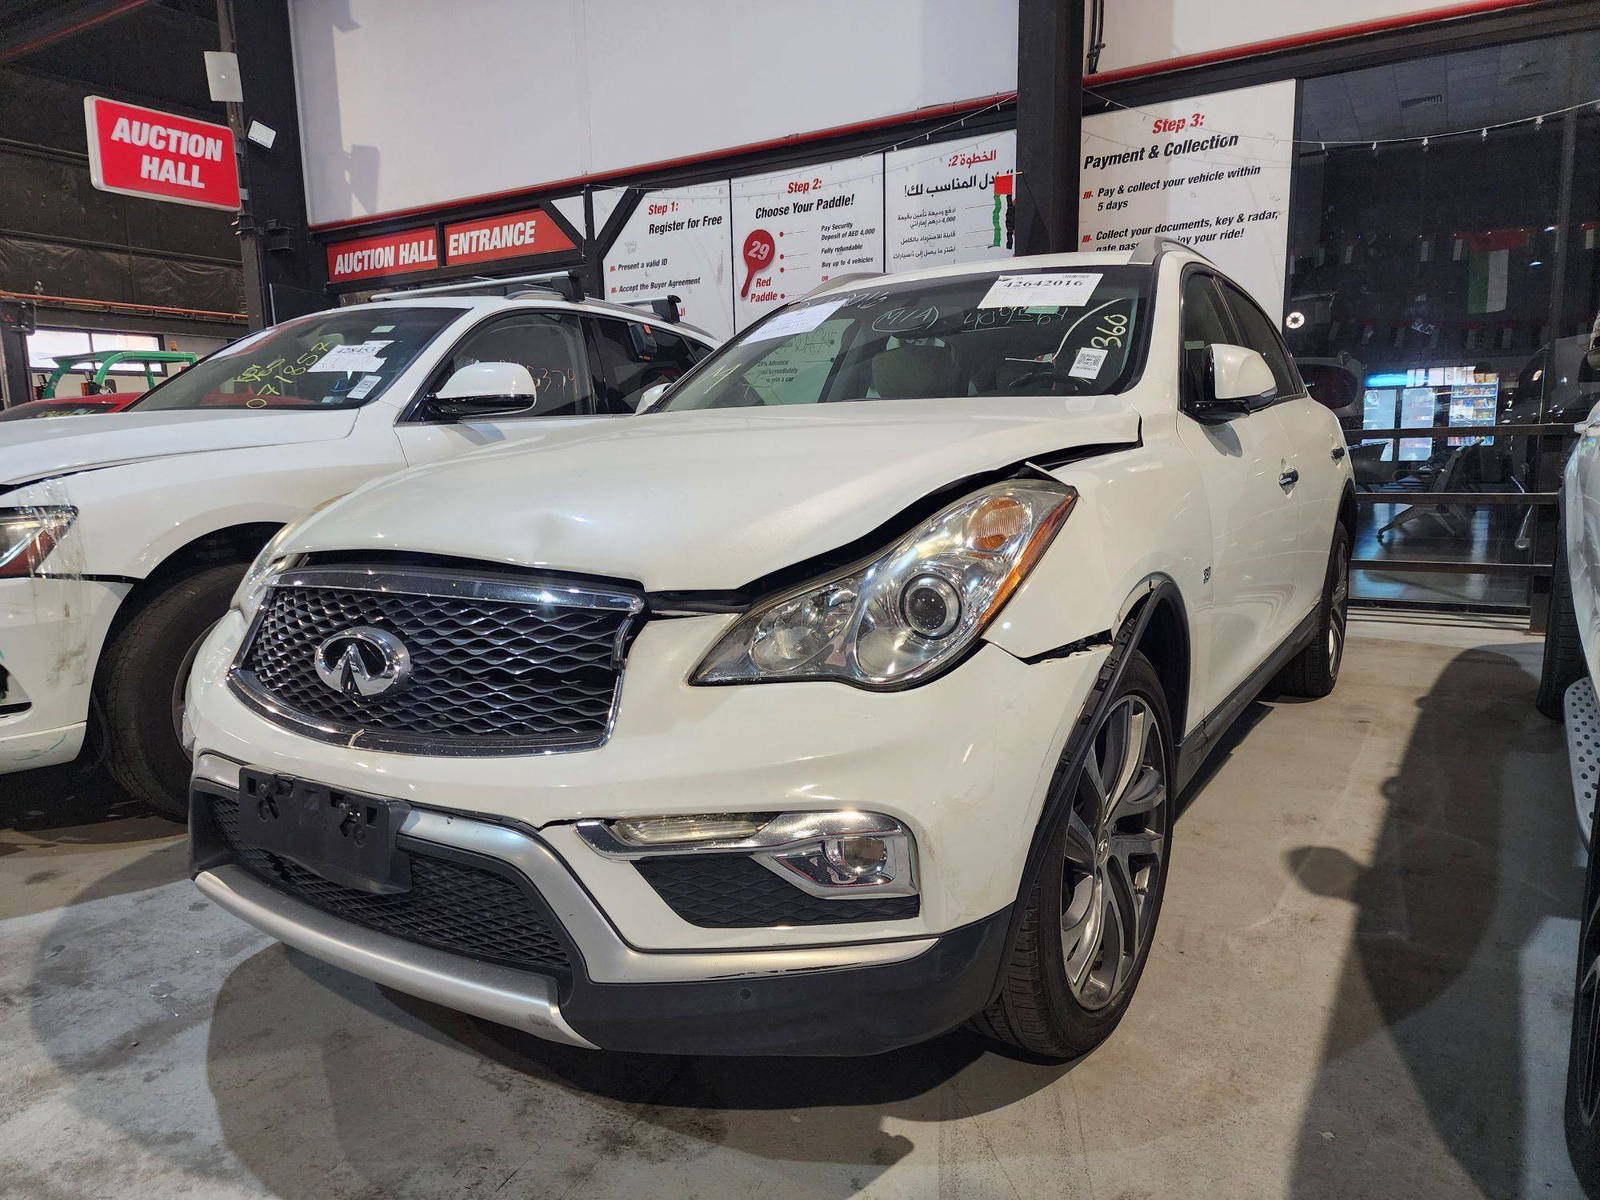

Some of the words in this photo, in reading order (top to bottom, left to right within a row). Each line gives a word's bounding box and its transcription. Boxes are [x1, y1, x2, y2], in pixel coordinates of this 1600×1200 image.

[1152, 118, 1186, 134] Step
[1190, 113, 1204, 128] 3:
[111, 117, 222, 162] AUCTION
[960, 149, 997, 168] الخطوة
[1083, 147, 1145, 170] Payment
[1148, 145, 1160, 160] &
[1163, 135, 1239, 157] Collection
[140, 155, 205, 188] HALL
[787, 182, 810, 194] Step
[812, 178, 822, 190] 2:
[904, 184, 923, 198] لك!
[925, 174, 977, 198] المناسب
[1097, 187, 1115, 200] Pay
[1117, 185, 1125, 194] &
[1127, 181, 1160, 194] collect
[1163, 178, 1185, 190] your
[1187, 171, 1224, 184] vehicle
[1227, 165, 1261, 179] within
[648, 204, 668, 216] Step
[671, 201, 679, 212] 1:
[755, 206, 789, 219] Choose
[792, 202, 814, 214] Your
[816, 194, 855, 210] Paddle!
[1097, 202, 1103, 211] 5
[1105, 199, 1129, 212] days
[649, 222, 685, 236] Register
[687, 218, 700, 230] for
[702, 215, 723, 227] Free
[832, 222, 853, 231] Security
[860, 228, 876, 236] 4,000
[1096, 228, 1128, 241] Collect
[1131, 226, 1152, 238] your
[1154, 217, 1213, 234] documents,
[1215, 215, 1234, 227] key
[1236, 213, 1245, 223] &
[1247, 209, 1279, 222] radar,
[1193, 233, 1217, 245] your
[1219, 228, 1245, 240] ride!
[334, 246, 395, 275] AUCTION
[399, 239, 436, 265] HALL
[448, 220, 536, 256] ENTRANCE
[747, 240, 770, 260] 29
[835, 244, 863, 252] refundable
[618, 262, 640, 271] Present
[646, 259, 660, 268] valid
[661, 258, 668, 266] ID
[852, 256, 873, 264] vehicles
[619, 284, 639, 294] Accept
[640, 282, 649, 290] the
[650, 281, 666, 289] Buyer
[668, 277, 701, 288] Agreement
[756, 277, 771, 288] Red
[1004, 279, 1084, 288] 42642016
[750, 291, 778, 302] Paddle
[1091, 314, 1128, 349] 360
